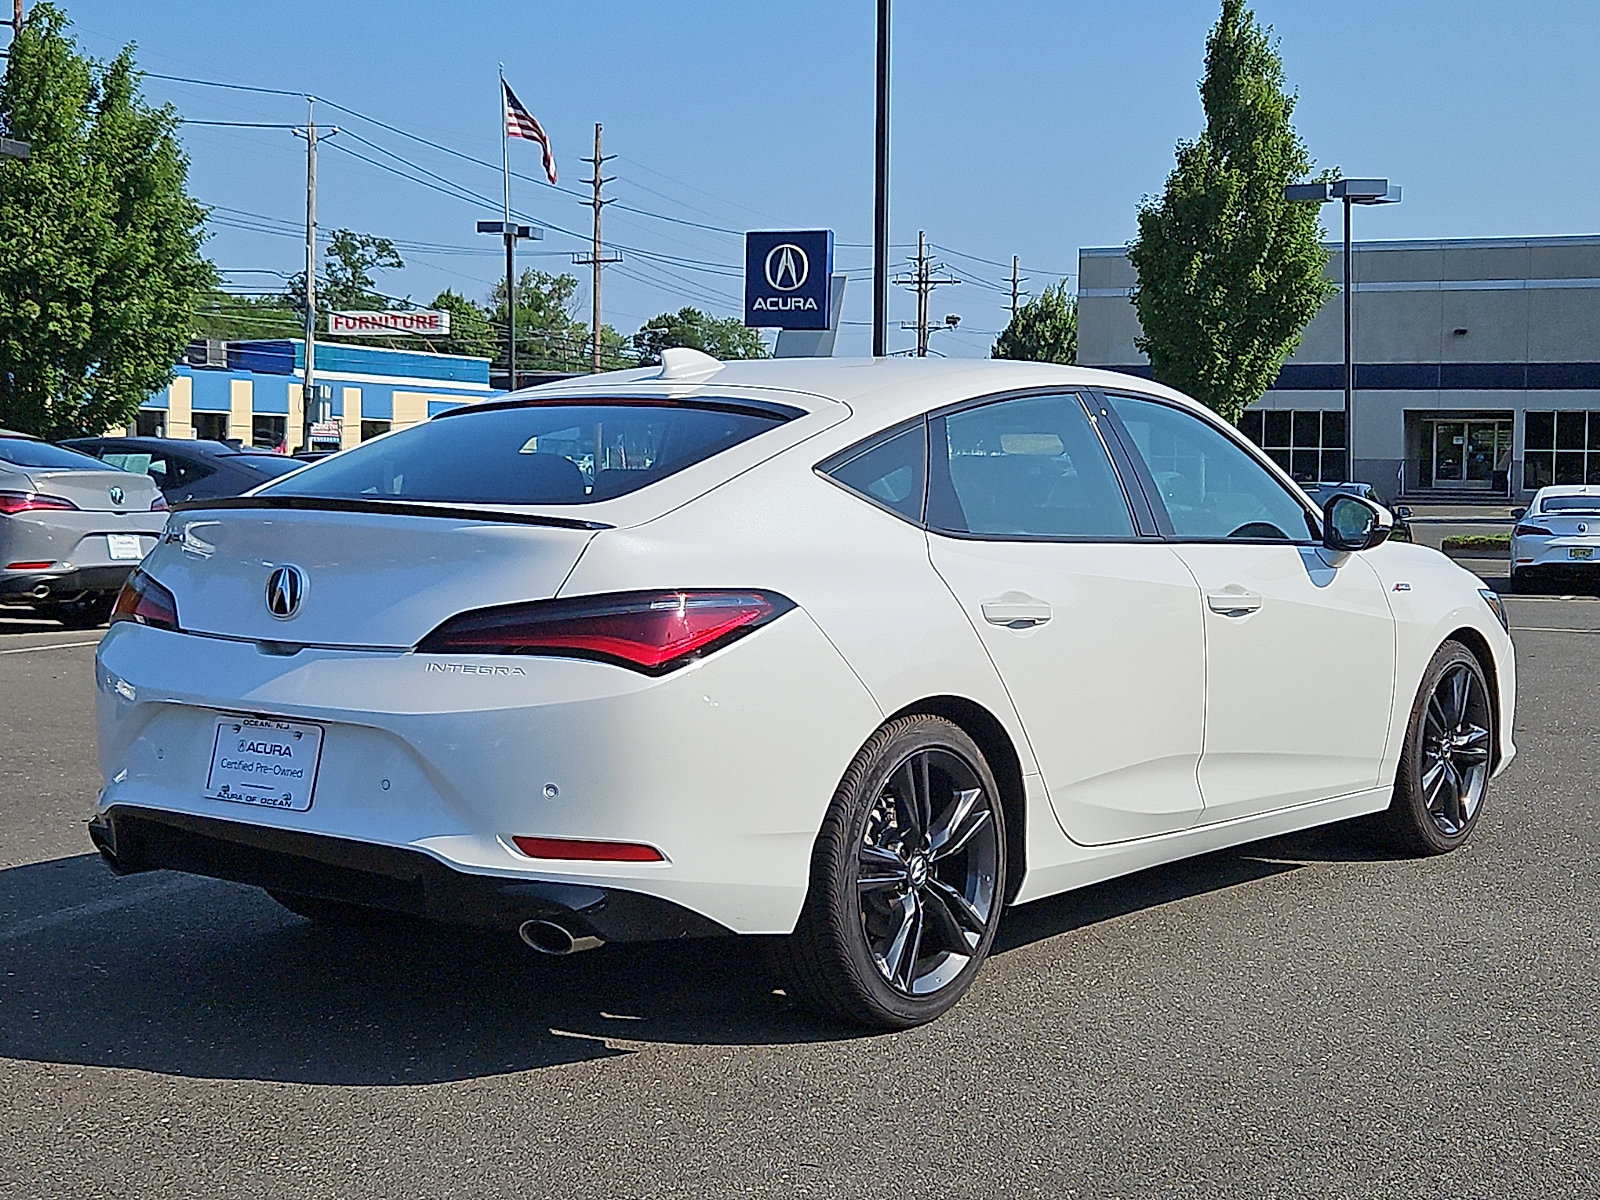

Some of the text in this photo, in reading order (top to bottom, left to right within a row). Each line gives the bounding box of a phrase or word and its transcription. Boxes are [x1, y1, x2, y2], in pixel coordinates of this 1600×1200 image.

[752, 297, 818, 310] ACURA
[333, 314, 440, 330] FURNITURE
[425, 662, 527, 676] INTEGRA
[246, 741, 292, 758] ACURA
[220, 758, 303, 779] Certified Pre-Owned
[216, 791, 243, 801] ACURA
[260, 797, 292, 808] OCEAN
